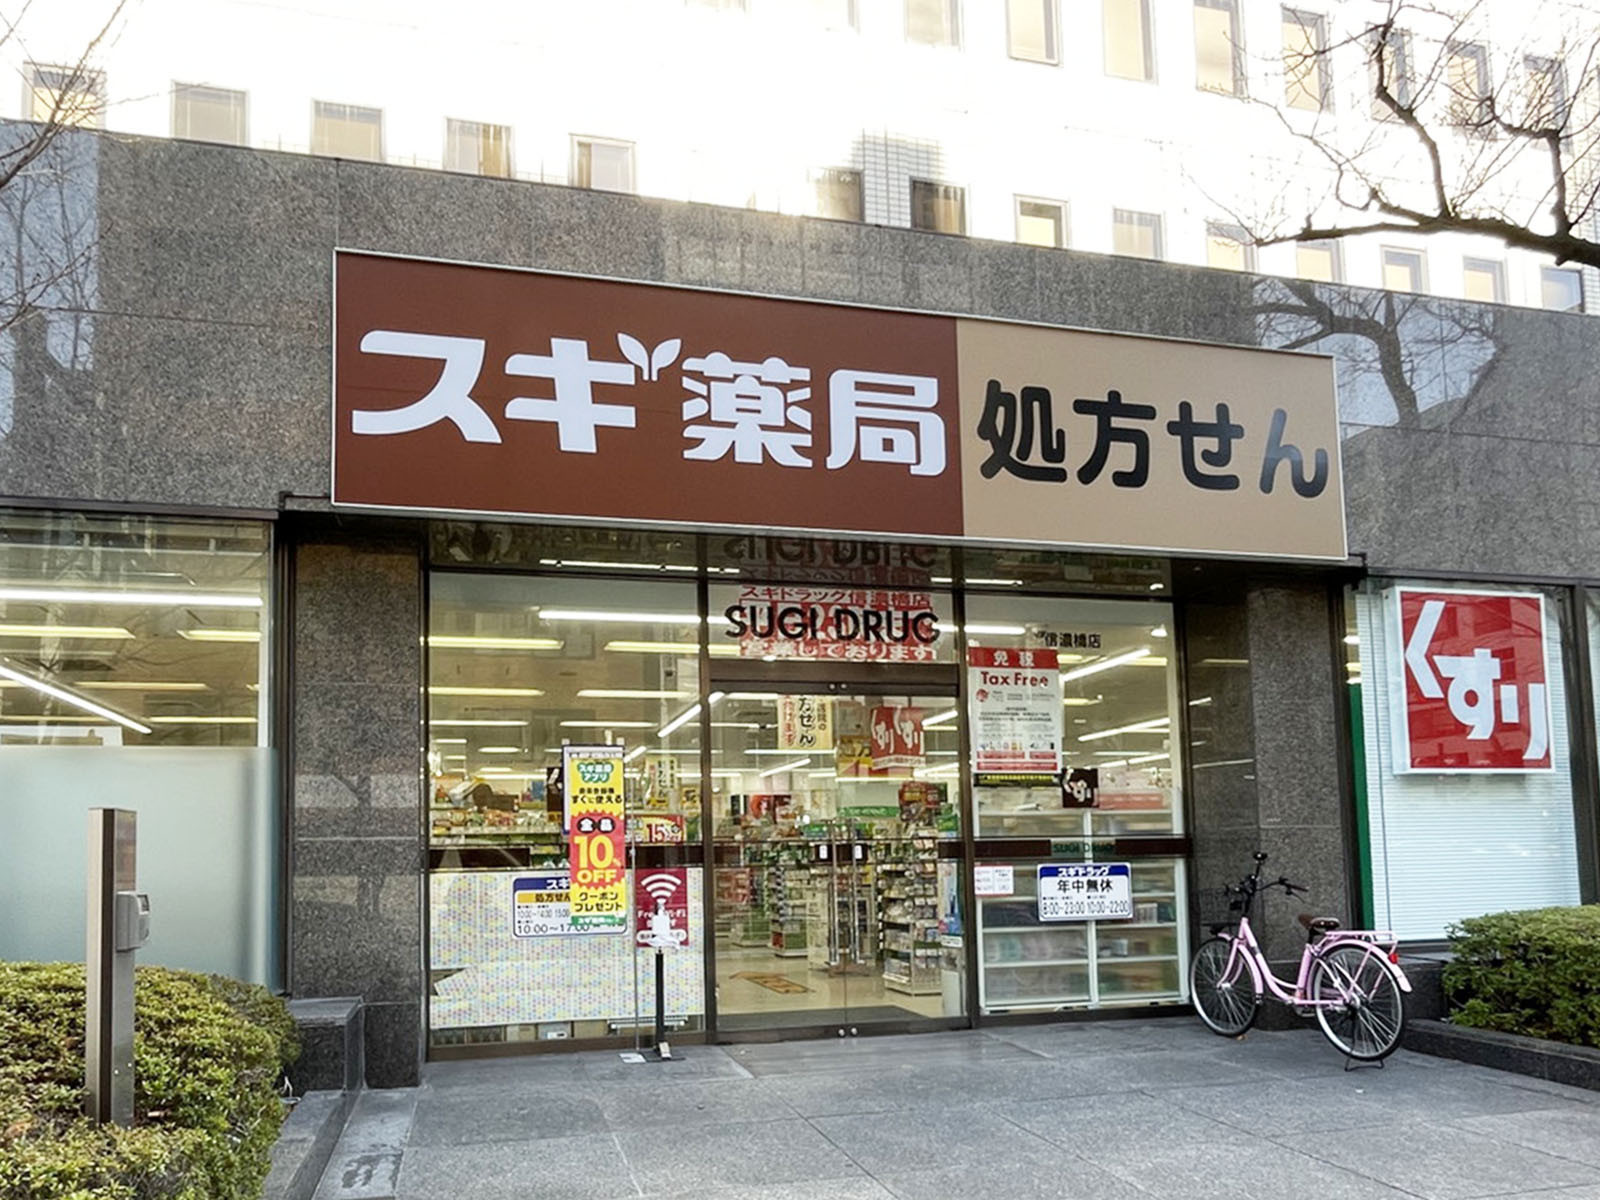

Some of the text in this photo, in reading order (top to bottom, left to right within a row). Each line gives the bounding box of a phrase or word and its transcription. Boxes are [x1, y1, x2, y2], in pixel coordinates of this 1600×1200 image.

[352, 330, 947, 477] スギ薬局
[977, 379, 1329, 498] 処方せん
[724, 604, 941, 644] SUGI DRUG
[980, 671, 1049, 687] Tax Free
[1405, 600, 1548, 760] くすり
[577, 869, 617, 883] OFF
[1057, 878, 1113, 893] 年中無休
[579, 892, 618, 902] クーポン
[575, 902, 623, 912] プレゼント
